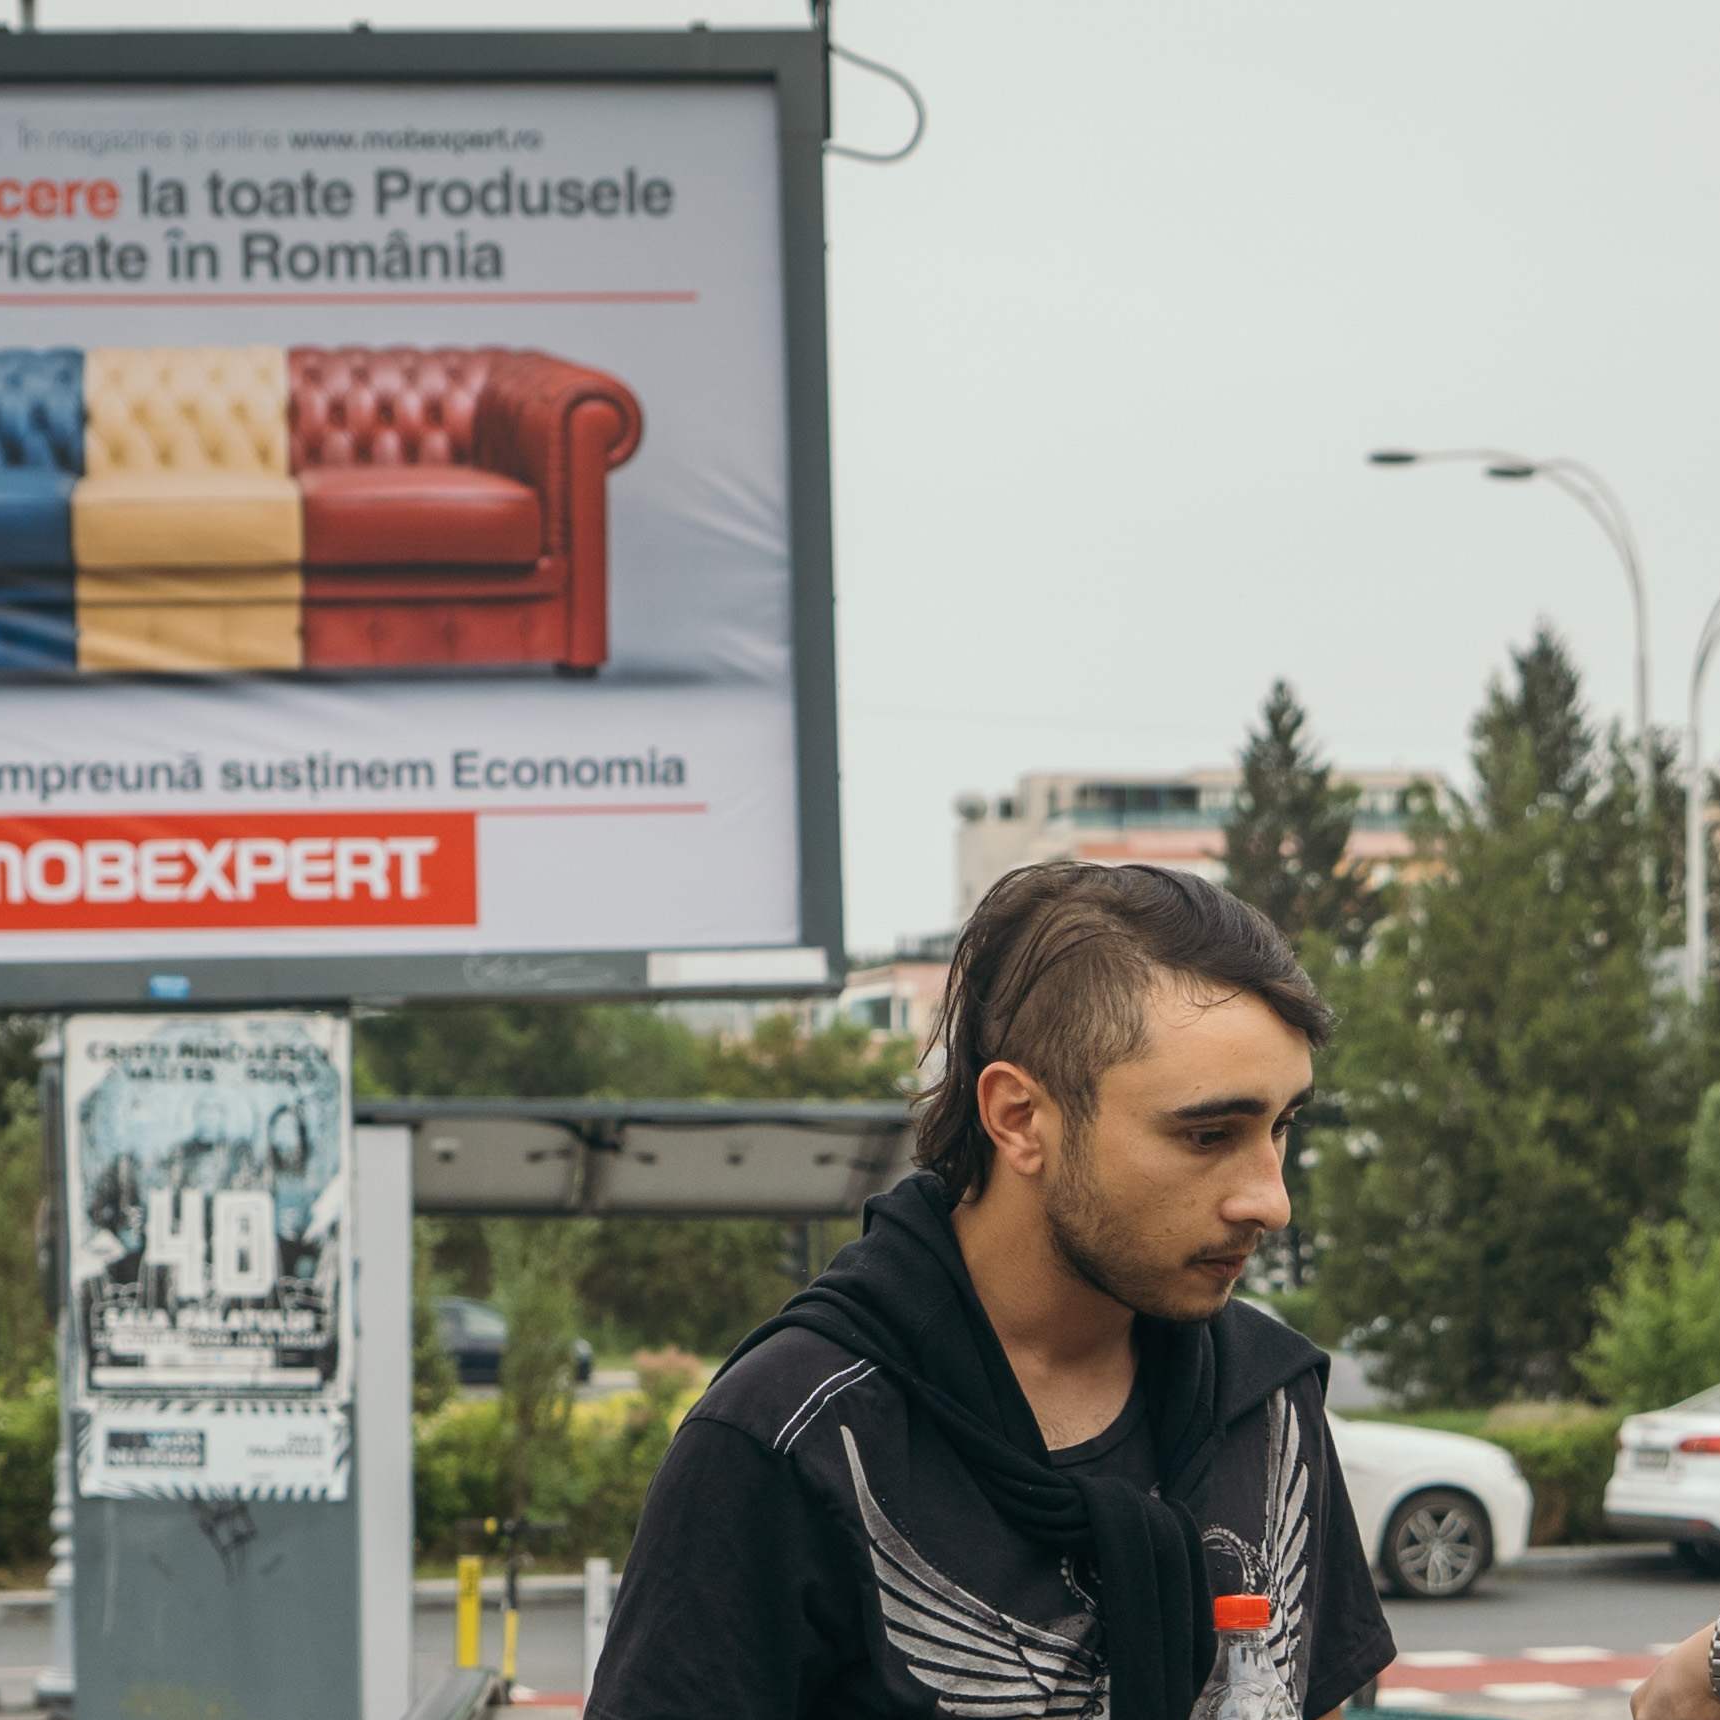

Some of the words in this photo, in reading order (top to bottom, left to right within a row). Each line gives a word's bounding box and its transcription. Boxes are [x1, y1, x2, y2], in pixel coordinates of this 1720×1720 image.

[139, 165, 188, 218] la
[206, 168, 355, 218] toate
[374, 167, 674, 218] Produsele
[165, 228, 220, 281] în
[242, 229, 504, 282] România
[452, 747, 688, 791] Economia
